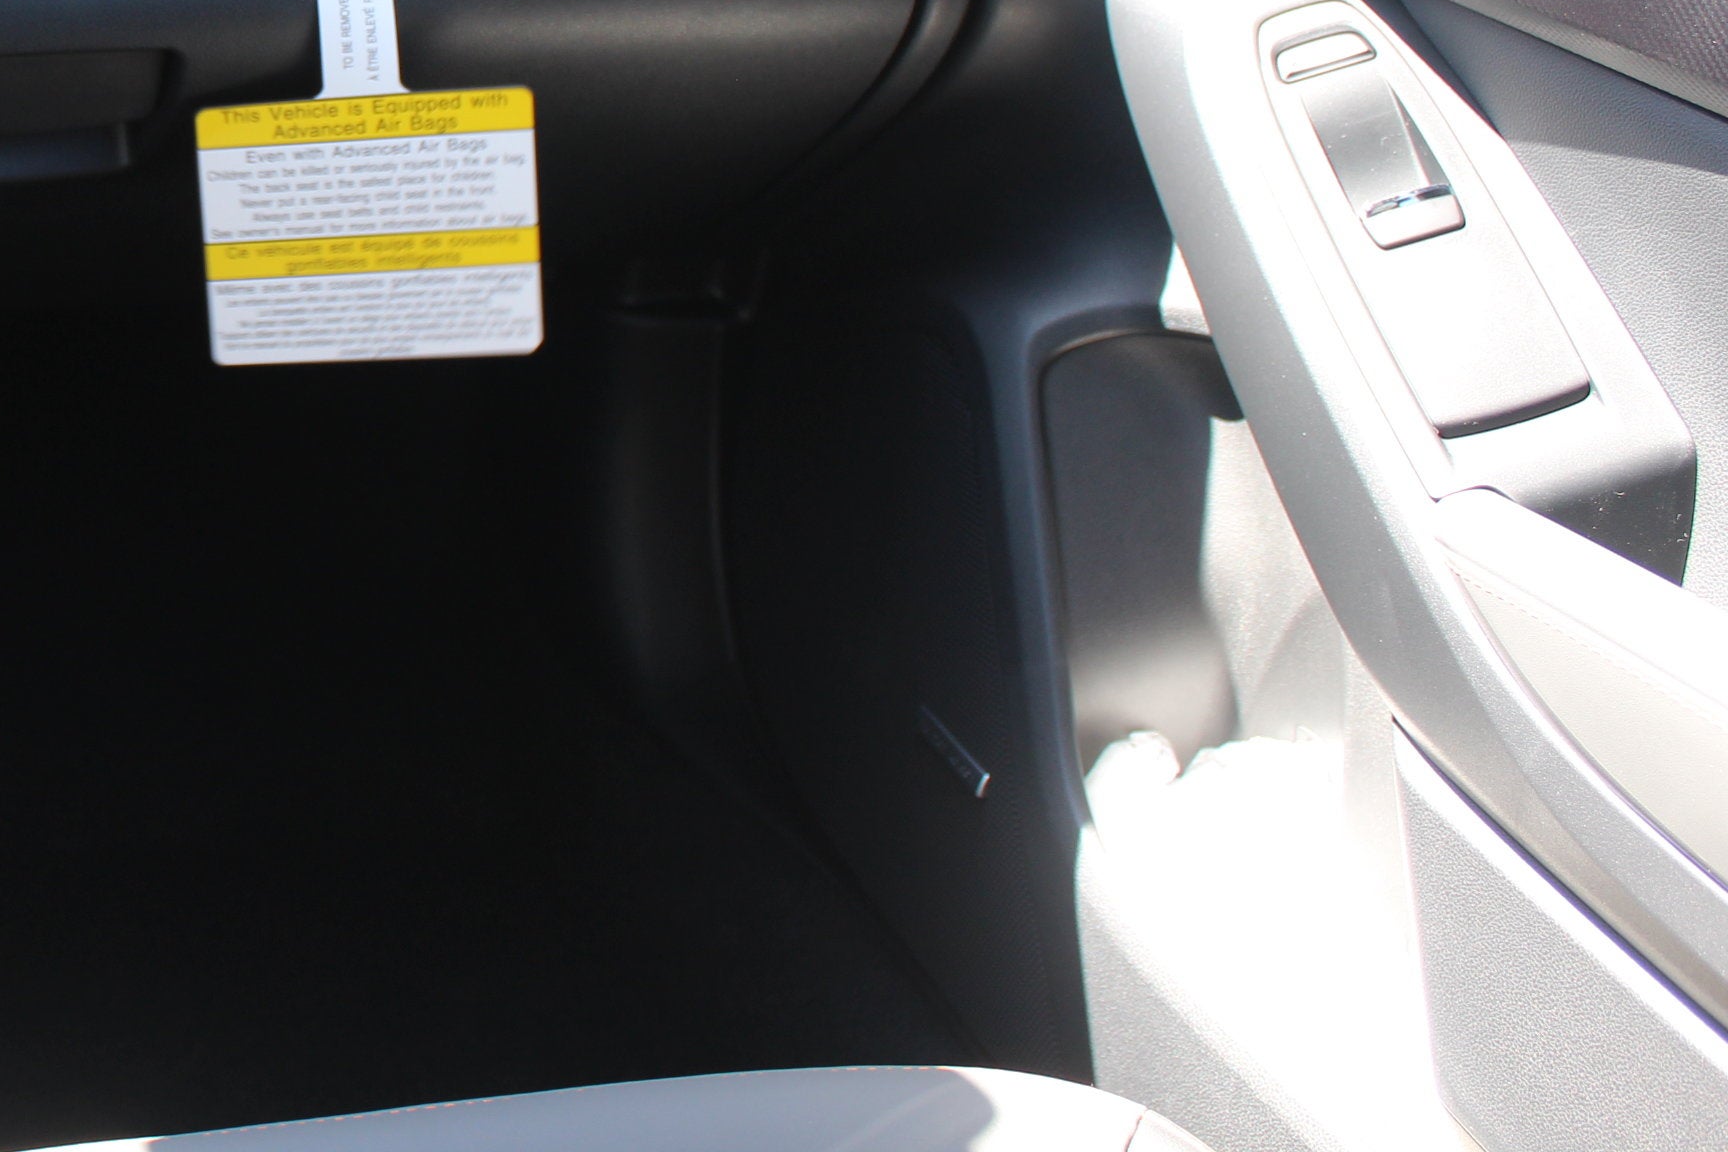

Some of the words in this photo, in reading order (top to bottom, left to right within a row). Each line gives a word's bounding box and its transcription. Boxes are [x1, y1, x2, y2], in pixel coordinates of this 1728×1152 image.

[342, 56, 354, 70] TO
[222, 109, 261, 125] This
[270, 103, 340, 122] Vehicle
[348, 103, 363, 116] is
[373, 95, 462, 116] Equipped
[471, 92, 509, 109] with
[273, 121, 367, 139] Advanced
[376, 118, 402, 133] Air
[410, 116, 460, 135] Bags
[245, 151, 286, 164] Even
[332, 142, 411, 159] Advanced
[417, 140, 441, 152] Air
[446, 138, 488, 153] Bags
